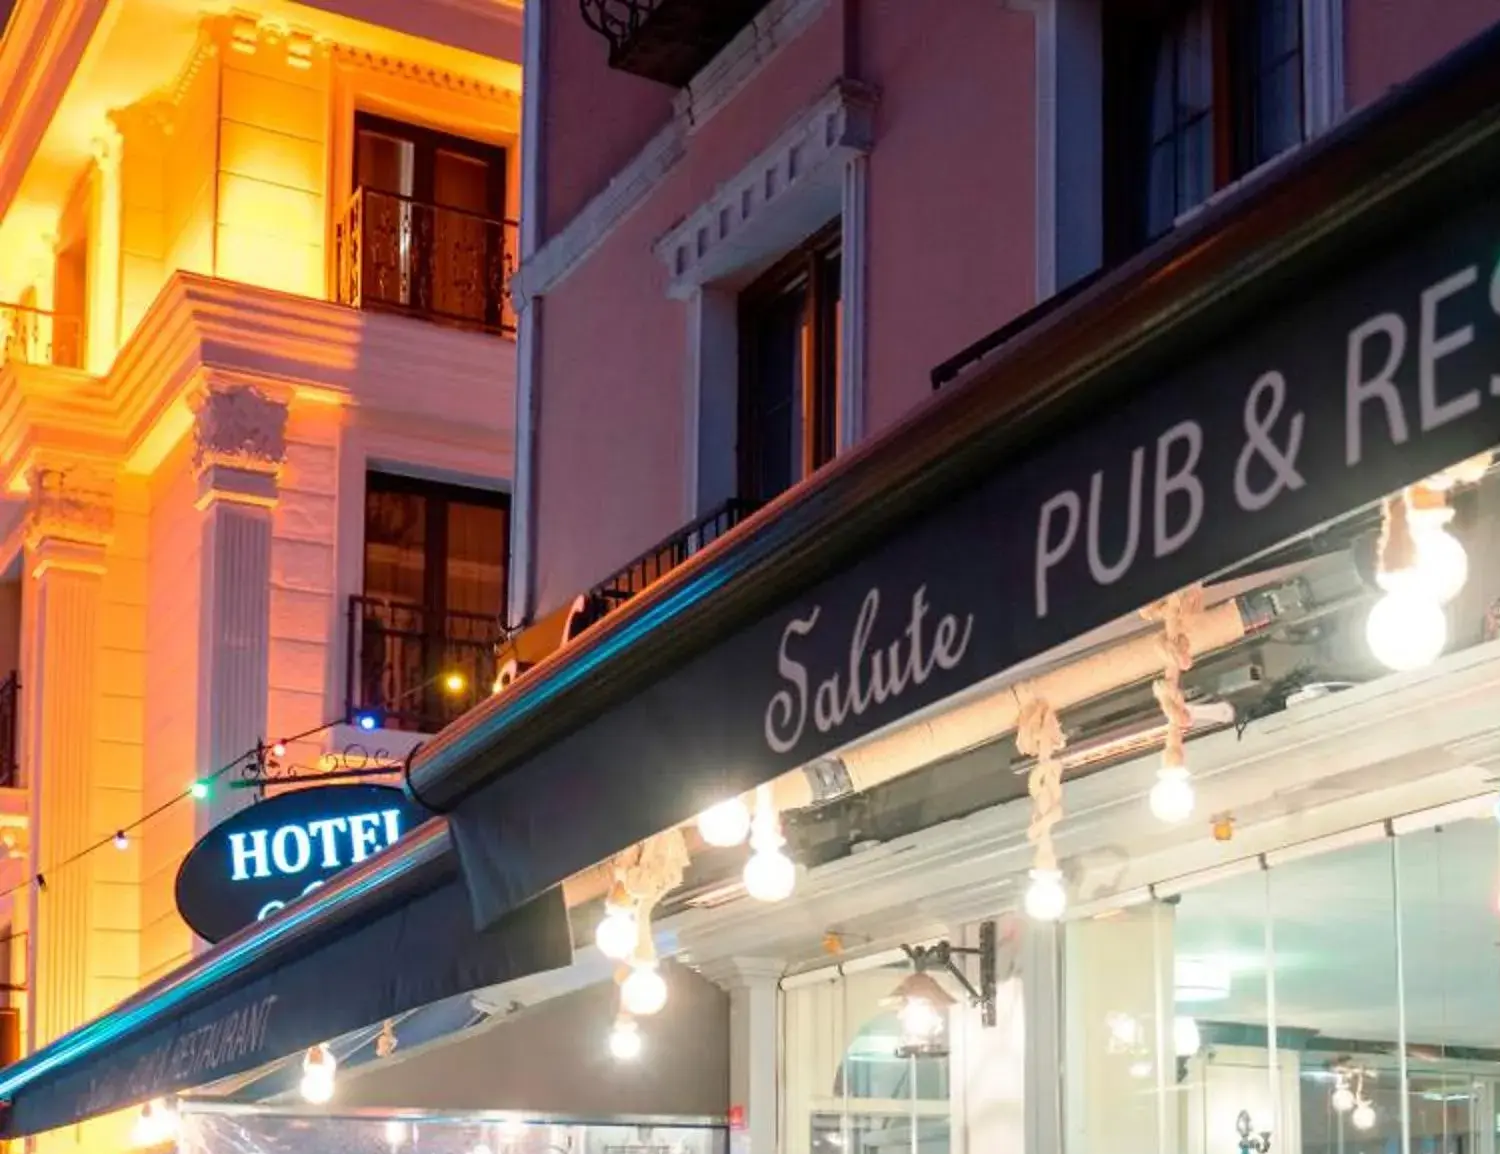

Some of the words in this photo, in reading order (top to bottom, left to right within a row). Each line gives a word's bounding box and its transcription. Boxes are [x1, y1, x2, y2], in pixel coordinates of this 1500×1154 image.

[764, 583, 973, 754] Salute
[1034, 419, 1203, 618] PUB
[1233, 369, 1307, 512] &
